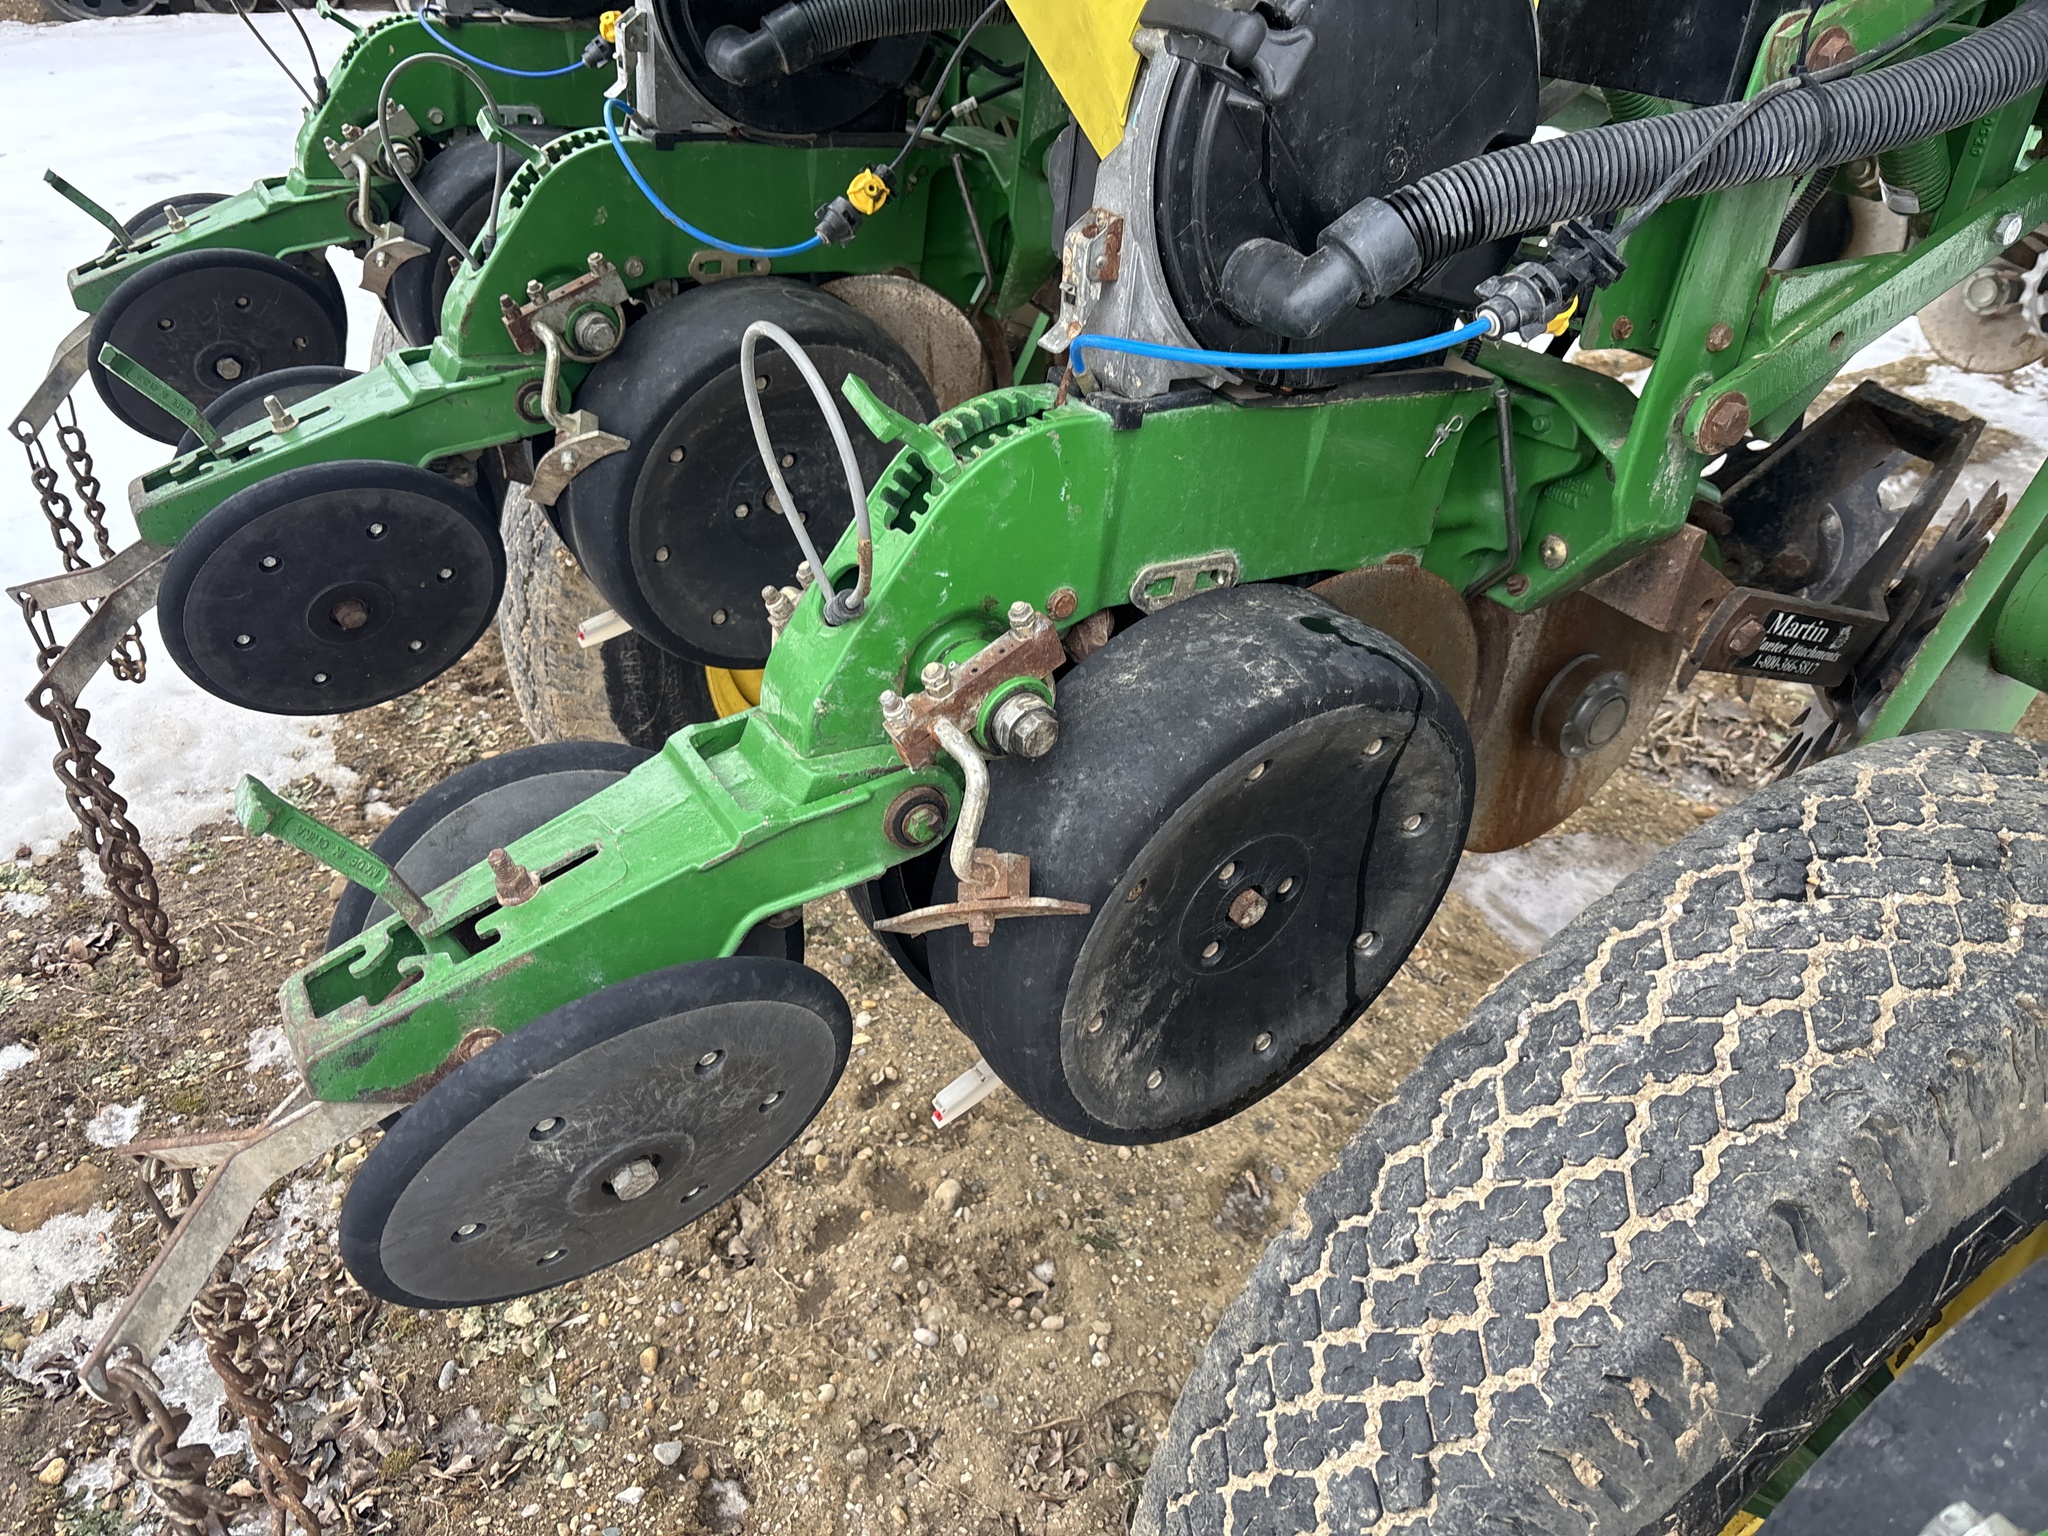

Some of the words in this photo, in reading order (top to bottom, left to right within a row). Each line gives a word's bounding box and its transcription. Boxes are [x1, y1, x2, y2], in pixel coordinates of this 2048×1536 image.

[1766, 612, 1830, 643] Martin
[1759, 636, 1788, 653] lanter
[1784, 642, 1841, 662] Attachments
[1752, 654, 1820, 675] 1-800-366-5817
[297, 826, 330, 850] CHINA
[332, 845, 346, 860] IN
[351, 856, 382, 880] MADE
